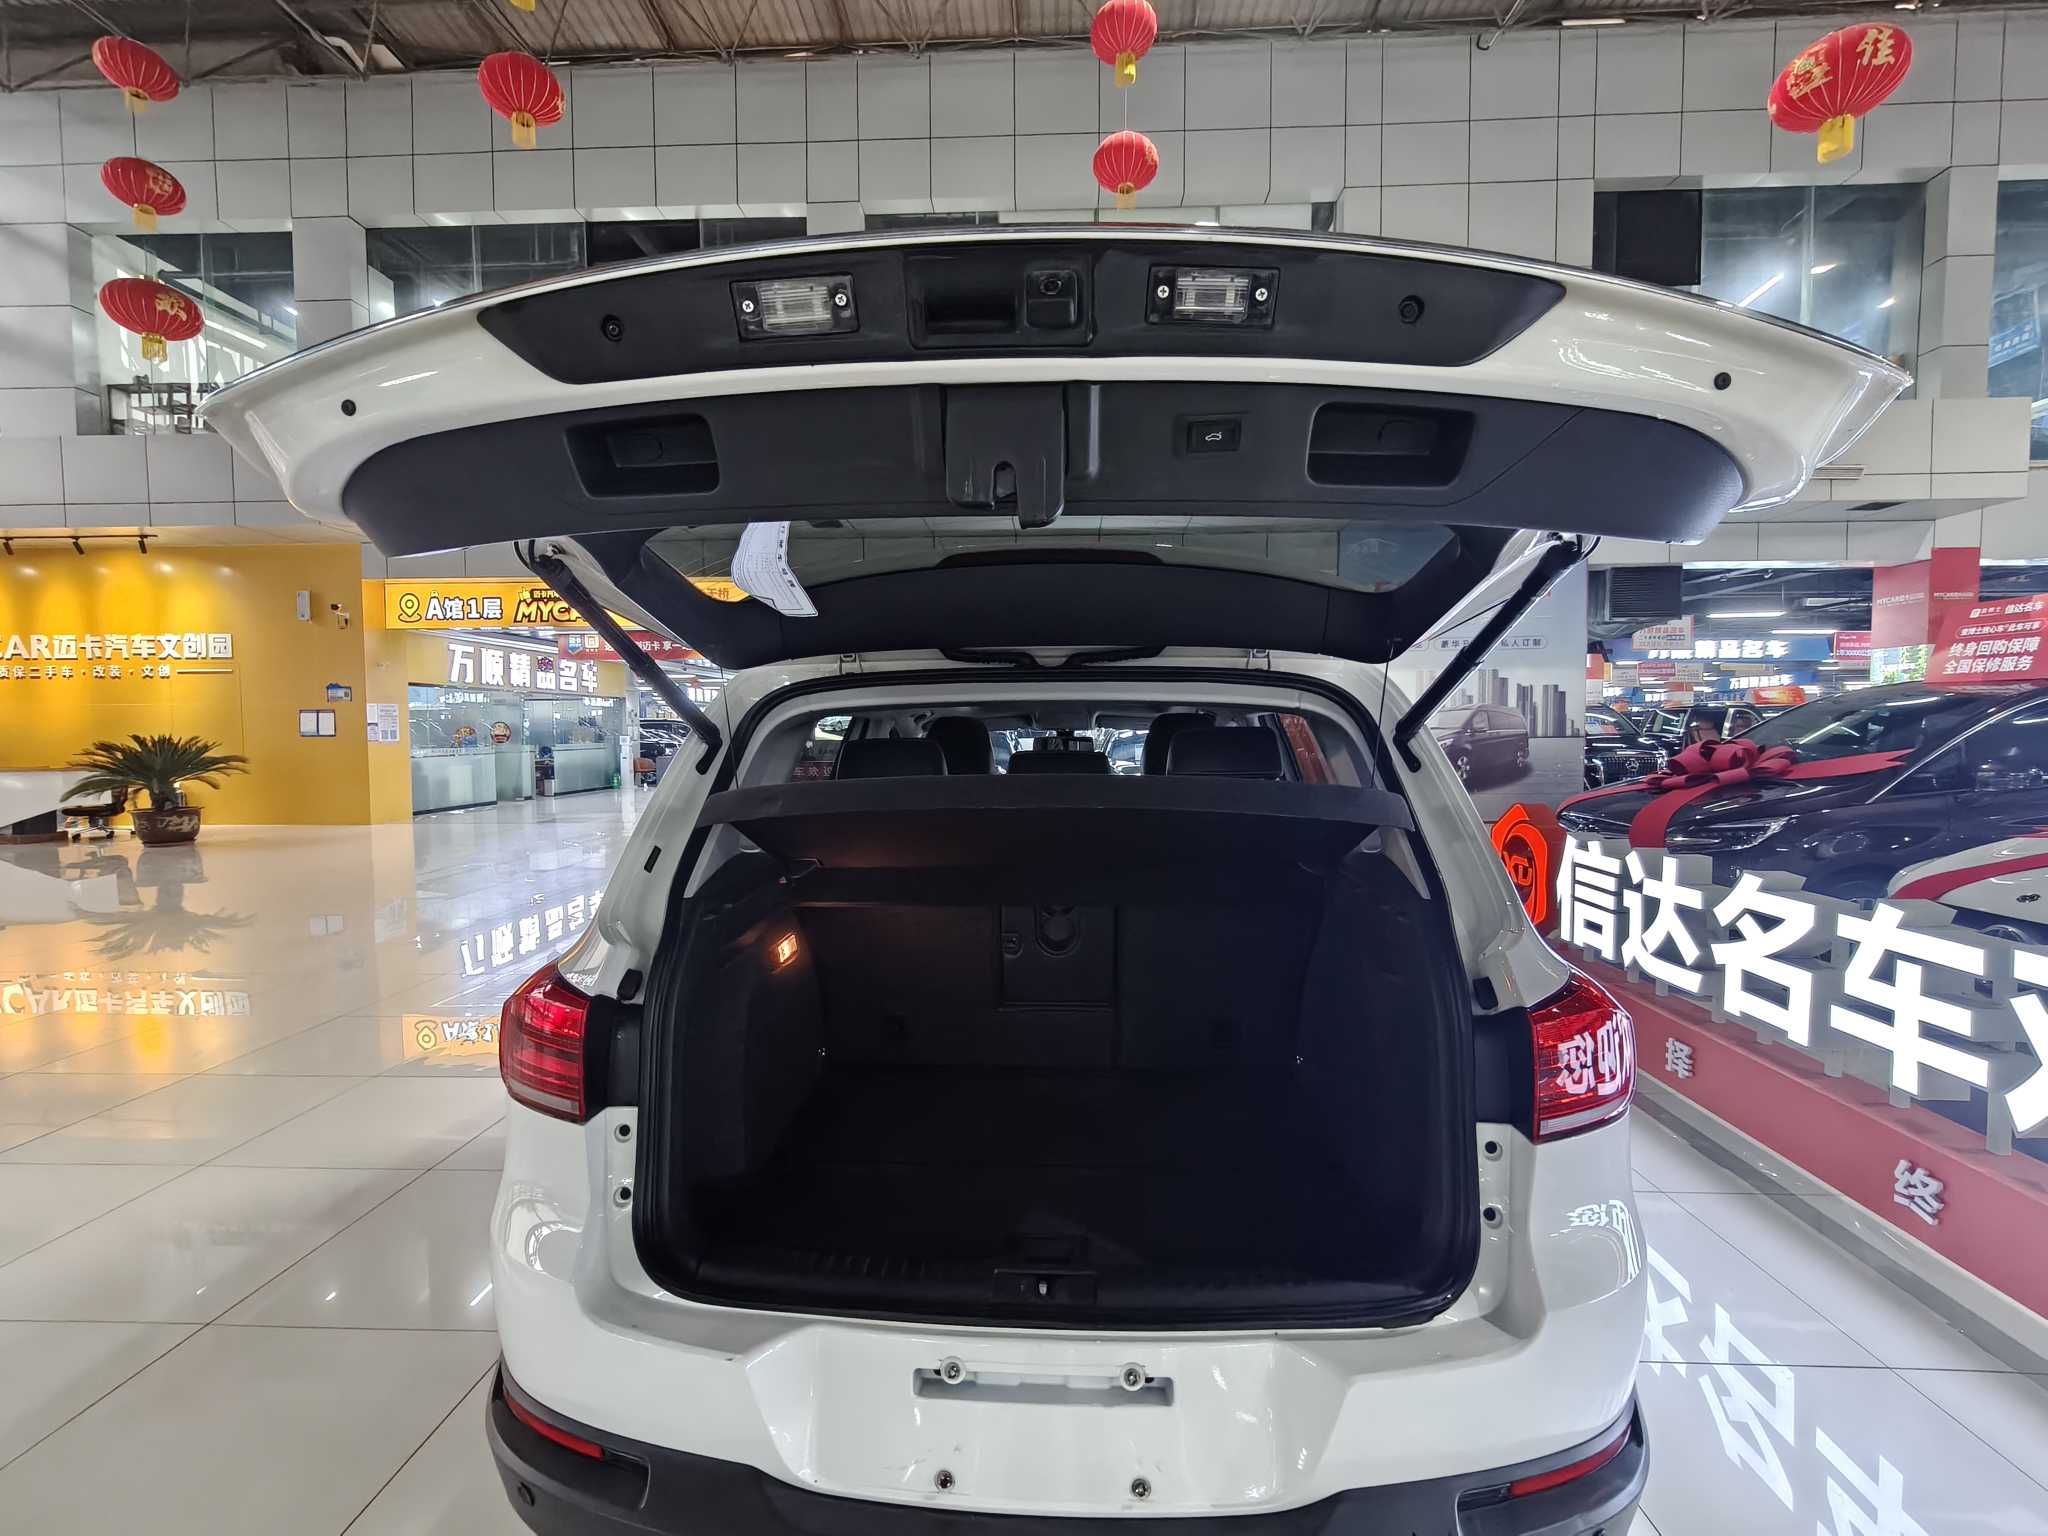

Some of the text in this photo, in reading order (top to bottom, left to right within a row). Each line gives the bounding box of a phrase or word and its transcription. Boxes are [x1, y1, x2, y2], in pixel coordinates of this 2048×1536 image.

[0, 632, 233, 660] AR迈卡汽车文创园
[1948, 636, 2041, 657] 终身回购保障
[1942, 655, 2034, 675] 全国保修服务
[1894, 1159, 1944, 1226] 终
